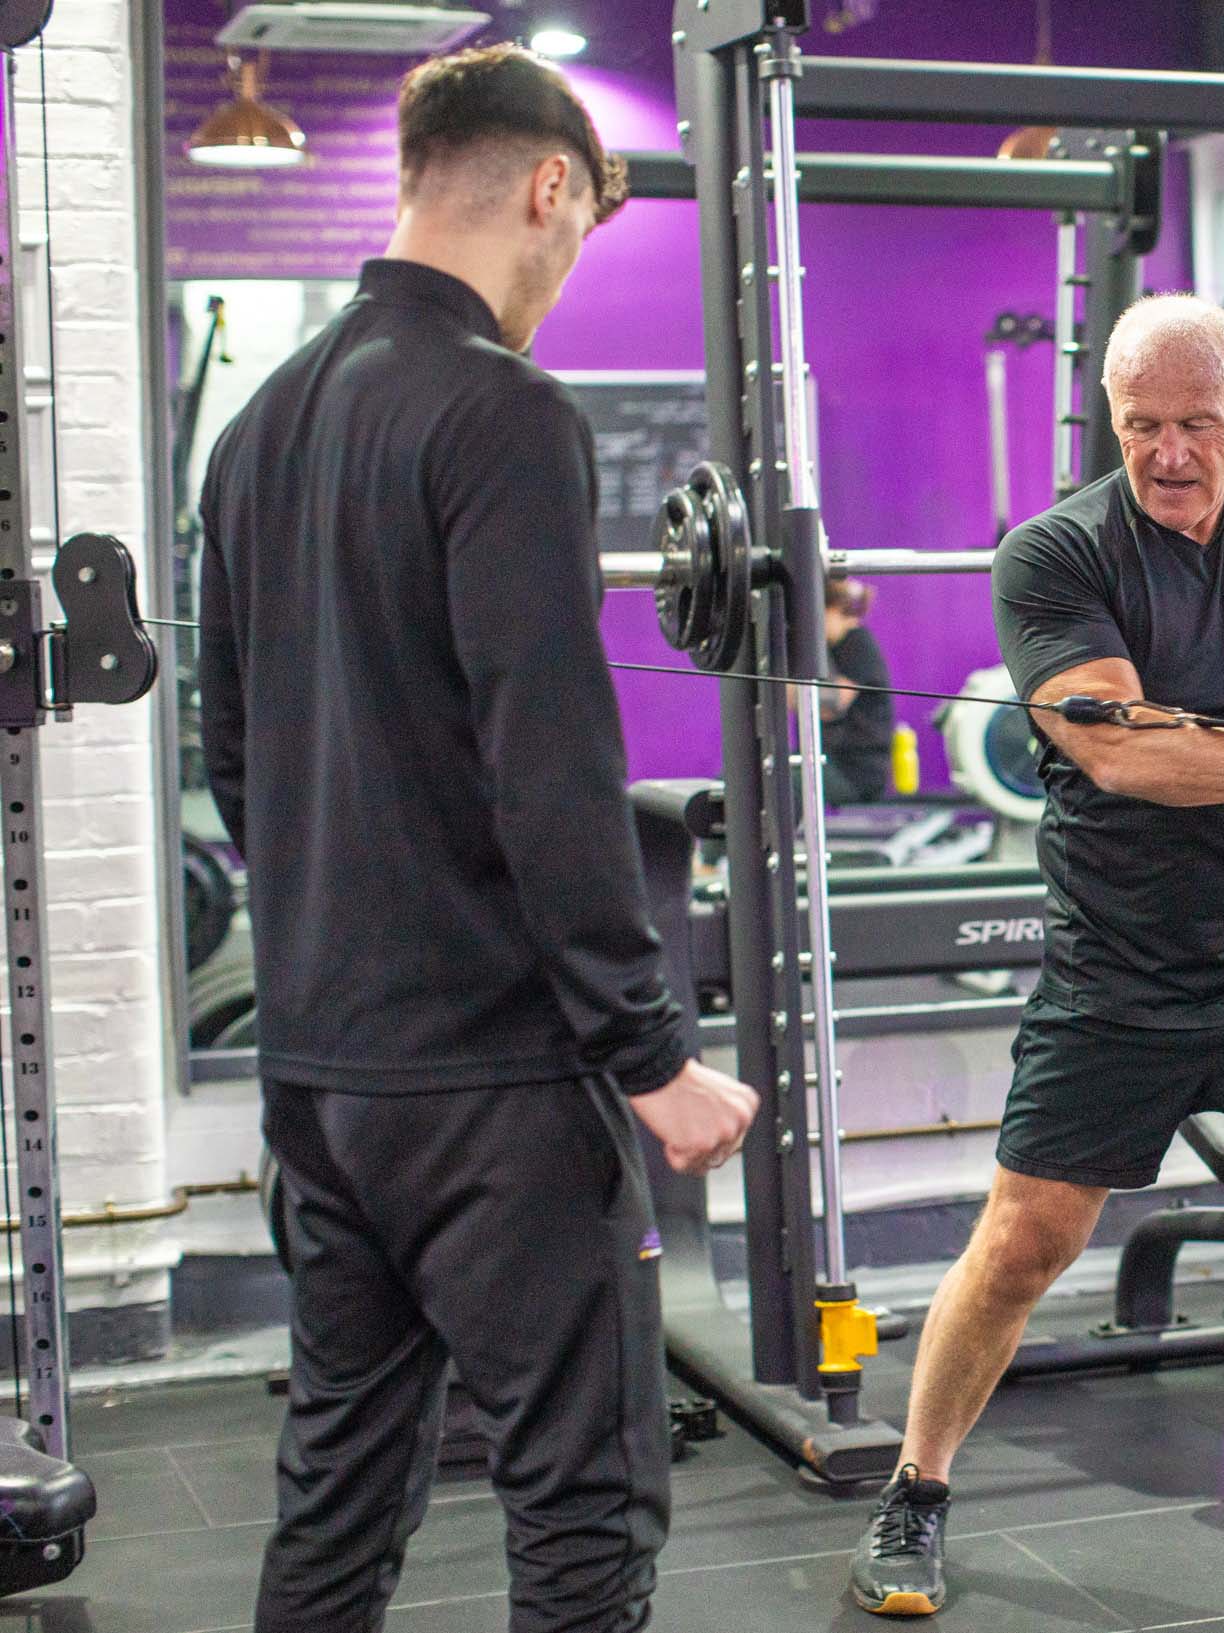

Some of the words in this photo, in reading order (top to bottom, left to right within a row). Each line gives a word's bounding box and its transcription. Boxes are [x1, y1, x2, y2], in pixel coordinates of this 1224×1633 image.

[0, 518, 11, 533] 6
[9, 752, 21, 767] 9
[9, 829, 31, 845] 10
[12, 907, 31, 922] 11
[16, 984, 36, 1000] 12
[20, 1061, 41, 1076] 13
[24, 1138, 44, 1153] 14
[28, 1214, 48, 1229] 15
[32, 1290, 52, 1305] 16
[35, 1366, 54, 1381] 17
